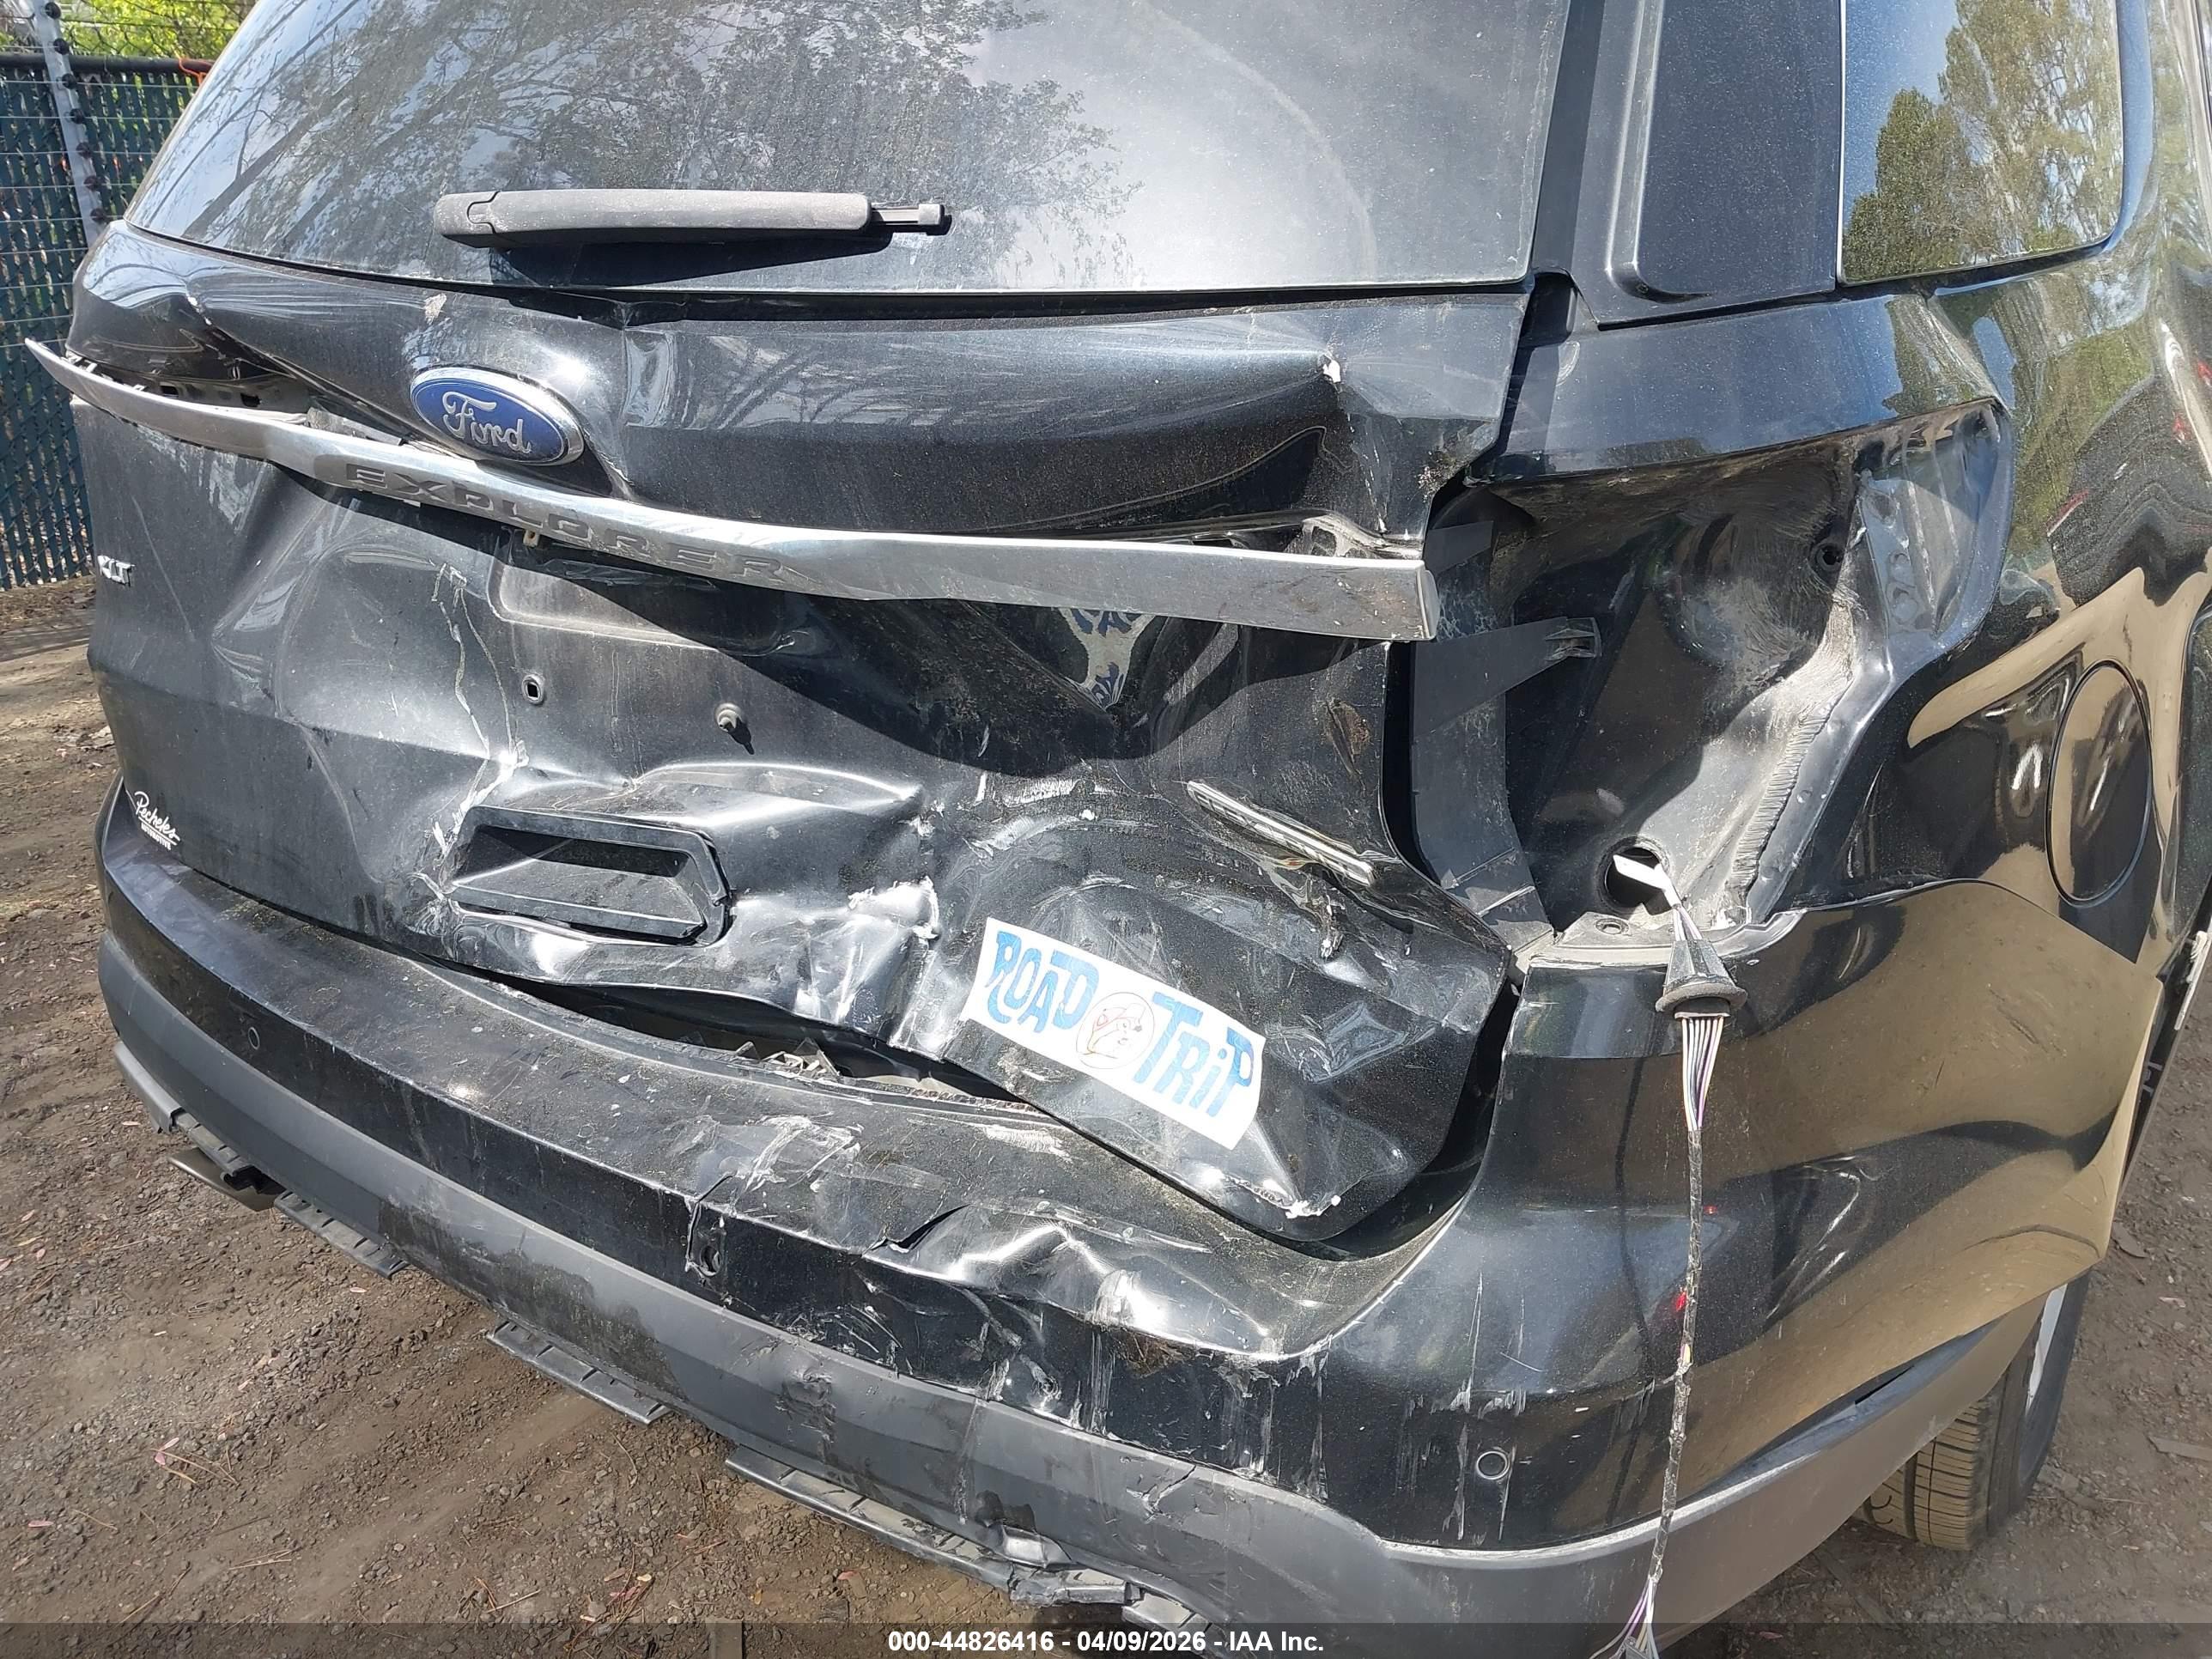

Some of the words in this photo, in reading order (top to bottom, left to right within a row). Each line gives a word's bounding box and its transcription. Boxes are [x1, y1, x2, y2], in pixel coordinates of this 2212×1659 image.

[442, 392, 532, 454] Ford
[346, 463, 786, 583] EXPLORER
[97, 555, 133, 586] XLT
[134, 791, 181, 842] Pecheles
[141, 822, 172, 851] AUTOMOTIVE
[1193, 790, 1260, 833] FLEX
[985, 930, 1100, 1034] ROAD
